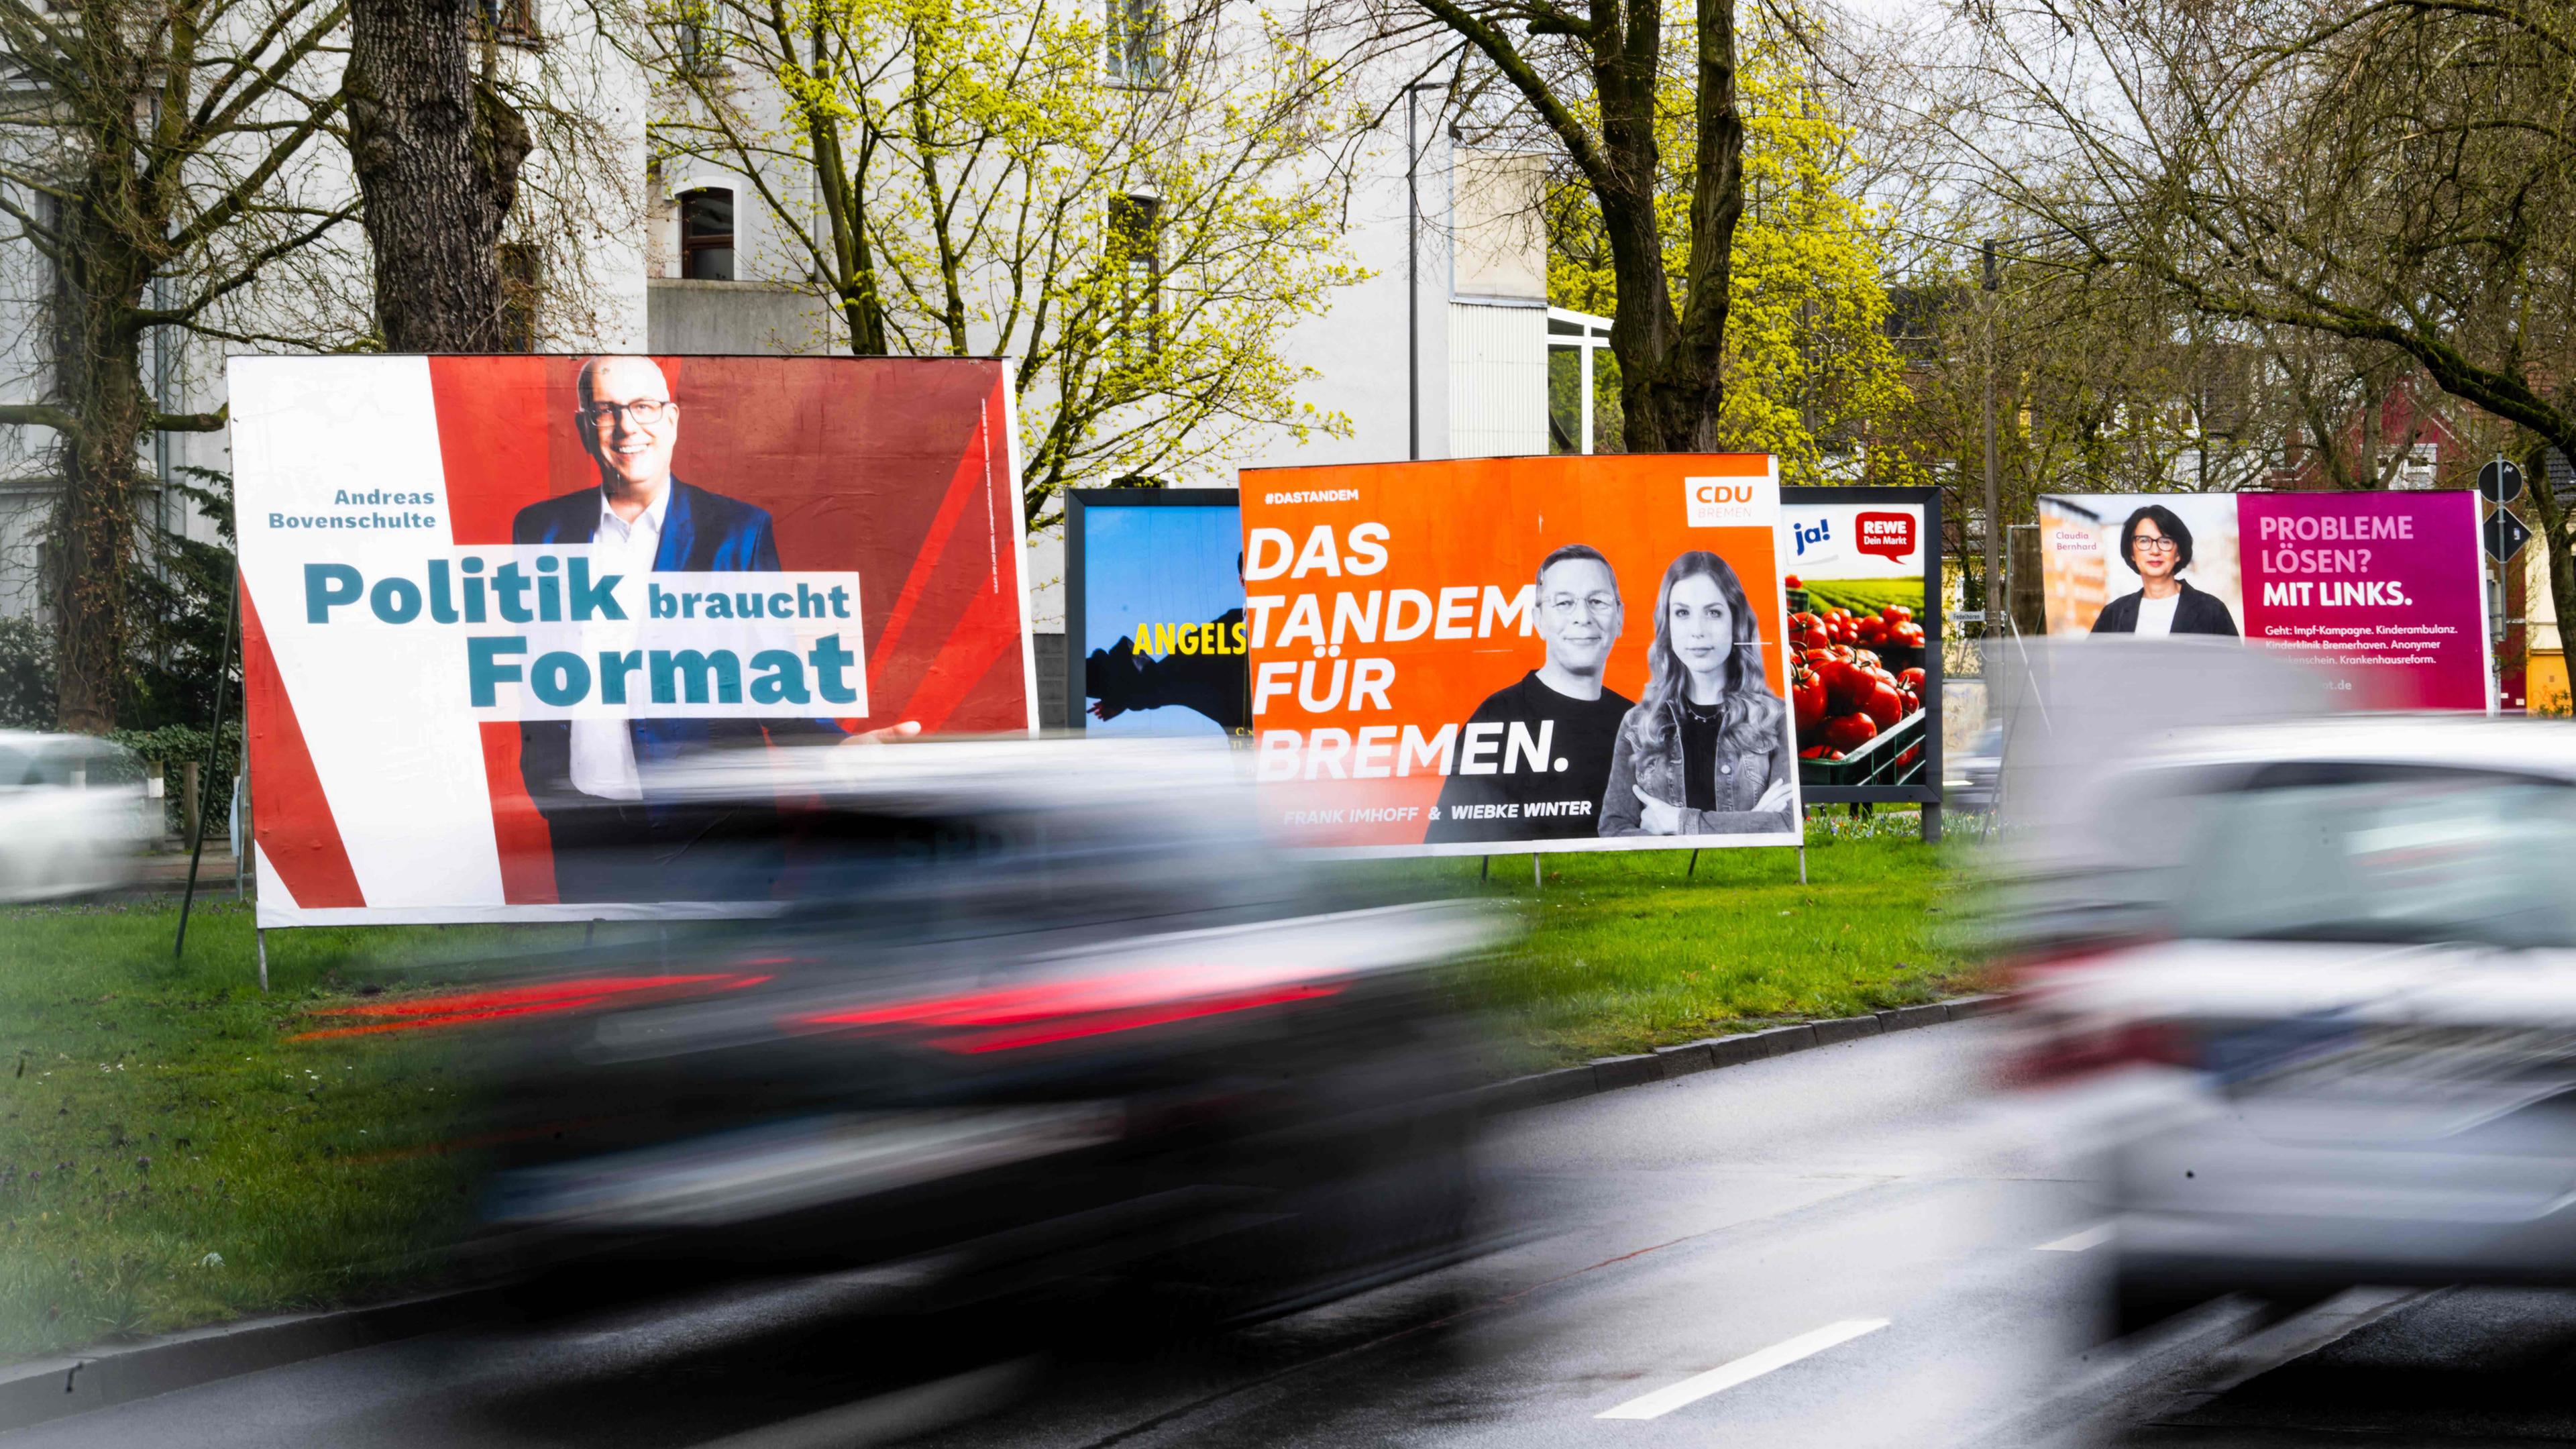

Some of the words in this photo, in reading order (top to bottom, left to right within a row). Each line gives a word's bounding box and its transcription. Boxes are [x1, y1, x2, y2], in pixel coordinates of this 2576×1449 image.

[335, 489, 435, 505] Andreas
[1265, 489, 1359, 504] #DASTANDEM
[1697, 486, 1752, 503] CDU
[269, 512, 435, 529] Bovenschulte
[1698, 508, 1752, 518] BREMEN
[1793, 519, 1831, 556] ja!
[1864, 521, 1907, 534] REWE
[2056, 531, 2089, 539] Claudia
[2260, 515, 2414, 541] PROBLEME
[1864, 536, 1881, 545] Dein
[1883, 536, 1907, 545] Markt
[2057, 542, 2097, 551] Bernhard
[1245, 522, 1391, 582] DAS
[2262, 542, 2372, 574] LÖSEN?
[304, 555, 628, 625] Politik
[649, 583, 850, 619] braucht
[2263, 582, 2314, 606] MIT
[2319, 581, 2413, 606] LINKS.
[1247, 585, 1536, 649] TANDEM
[1132, 623, 1247, 655] ANGELS
[2265, 625, 2292, 635] Geht:
[2294, 625, 2374, 637] Impf-Kampagne.
[2376, 624, 2458, 635] Kinderambulanz.
[2265, 641, 2320, 650] Kinderklinik
[2322, 640, 2388, 649] Bremerhaven.
[2391, 640, 2440, 651] Anonymer
[2340, 654, 2436, 664] Krankenhausreform.
[466, 633, 857, 708] Format
[1253, 643, 1396, 714] FÜR
[1256, 720, 1569, 782] BREMEN.
[1285, 809, 1344, 825] FRANK
[1349, 807, 1419, 822] IMHOFF
[1428, 806, 1441, 820] &
[1451, 804, 1519, 820] WIEBKE
[1523, 801, 1592, 816] WINTER
